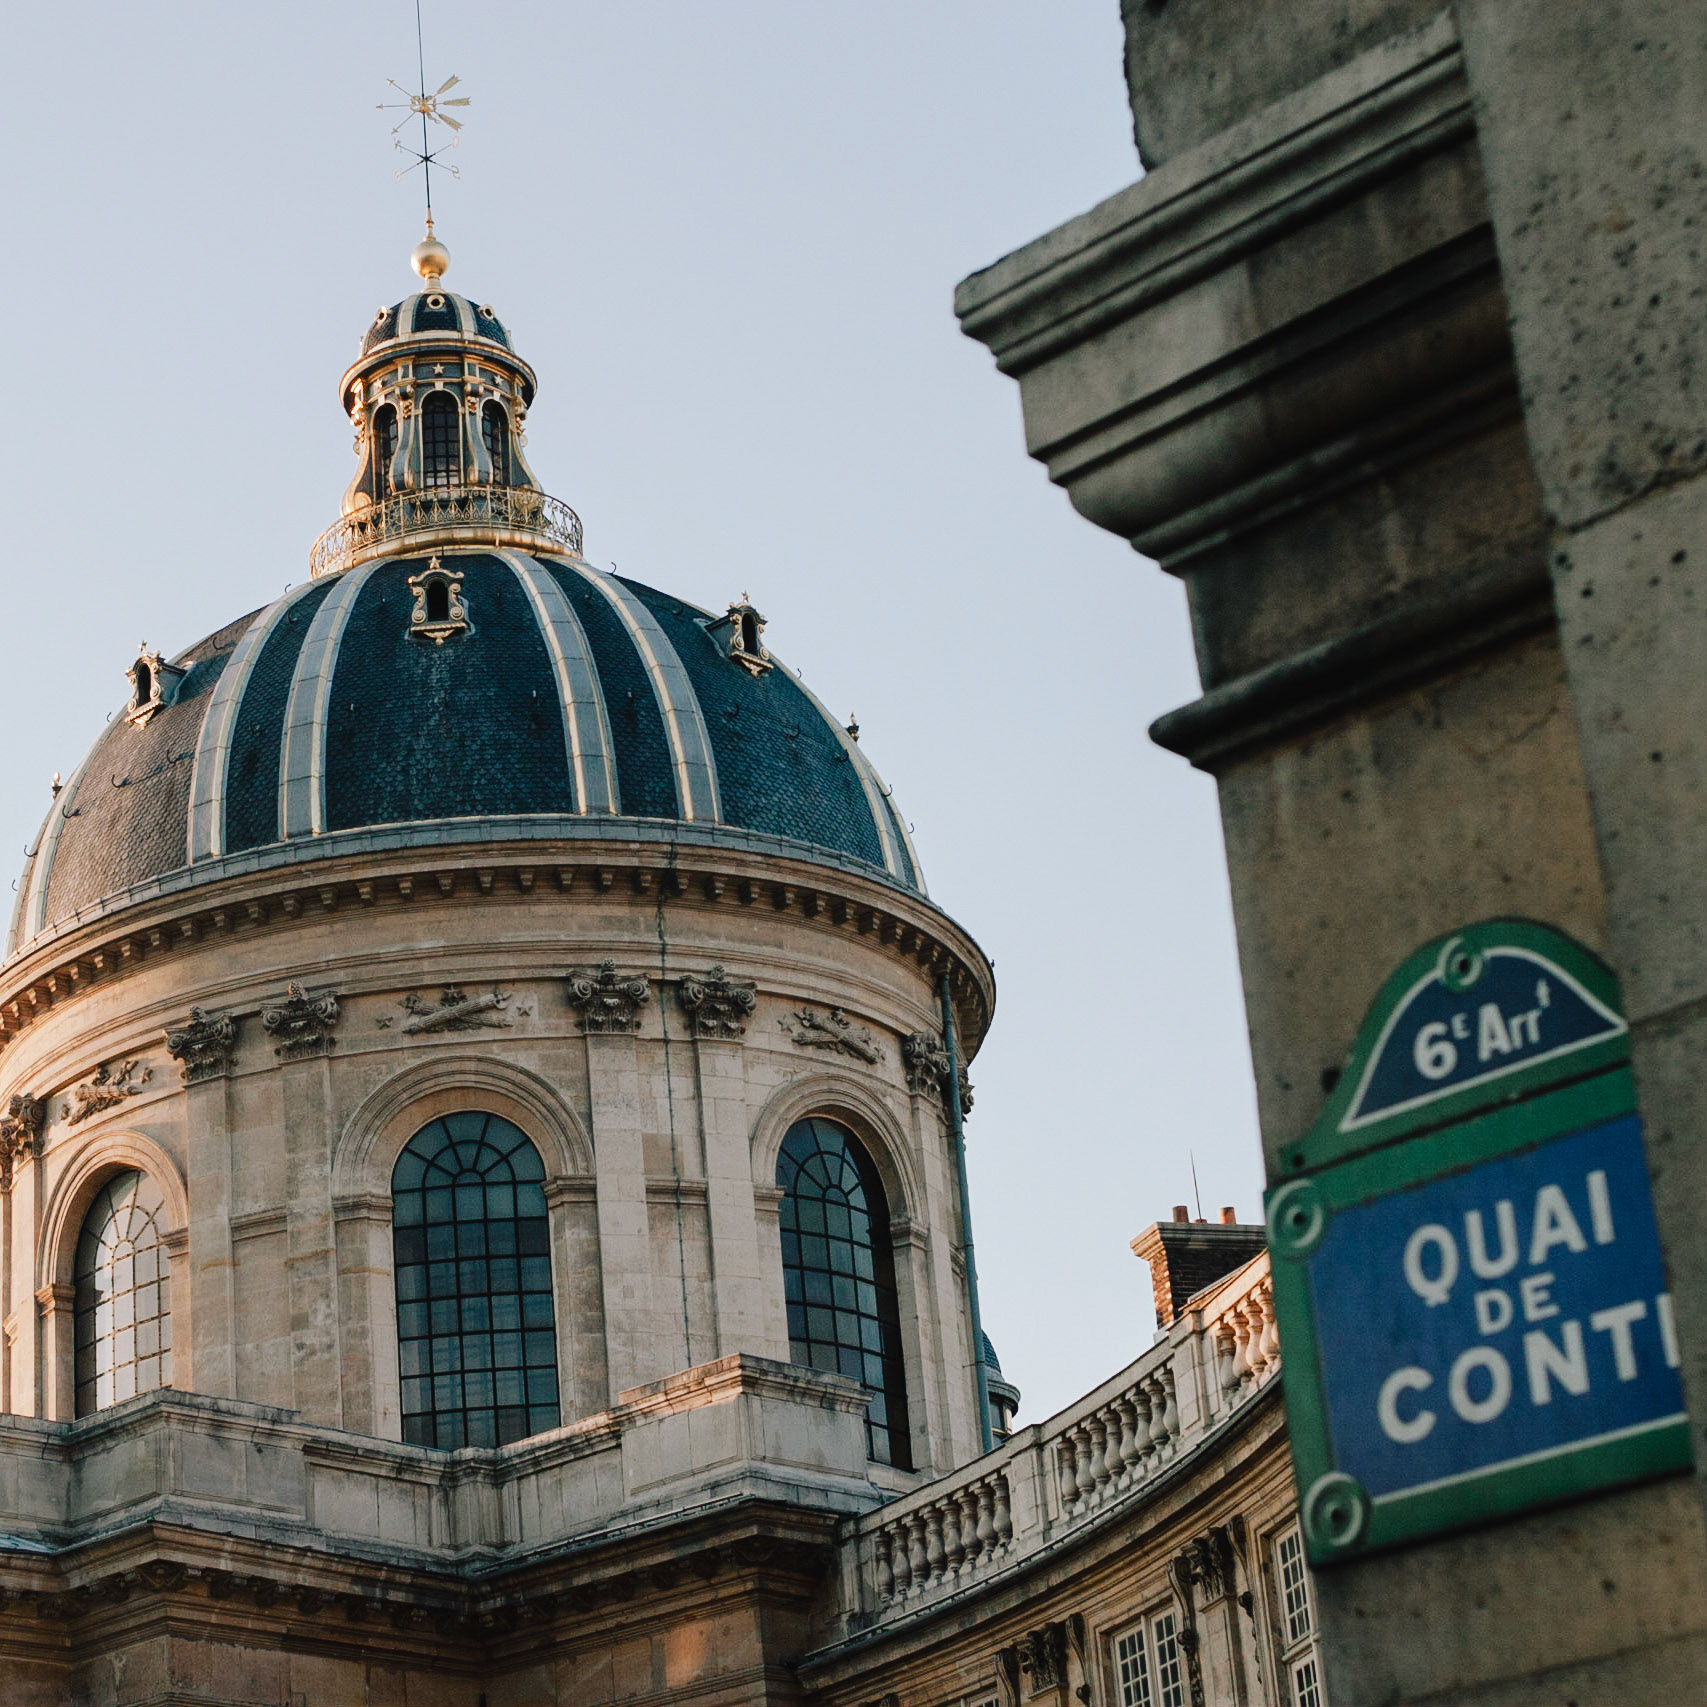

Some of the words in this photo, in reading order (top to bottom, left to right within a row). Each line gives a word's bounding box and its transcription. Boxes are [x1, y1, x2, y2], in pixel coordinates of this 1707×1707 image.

[1404, 1170, 1615, 1306] QUAI
[1476, 1272, 1560, 1336] DE
[1378, 1293, 1681, 1443] CONTI
